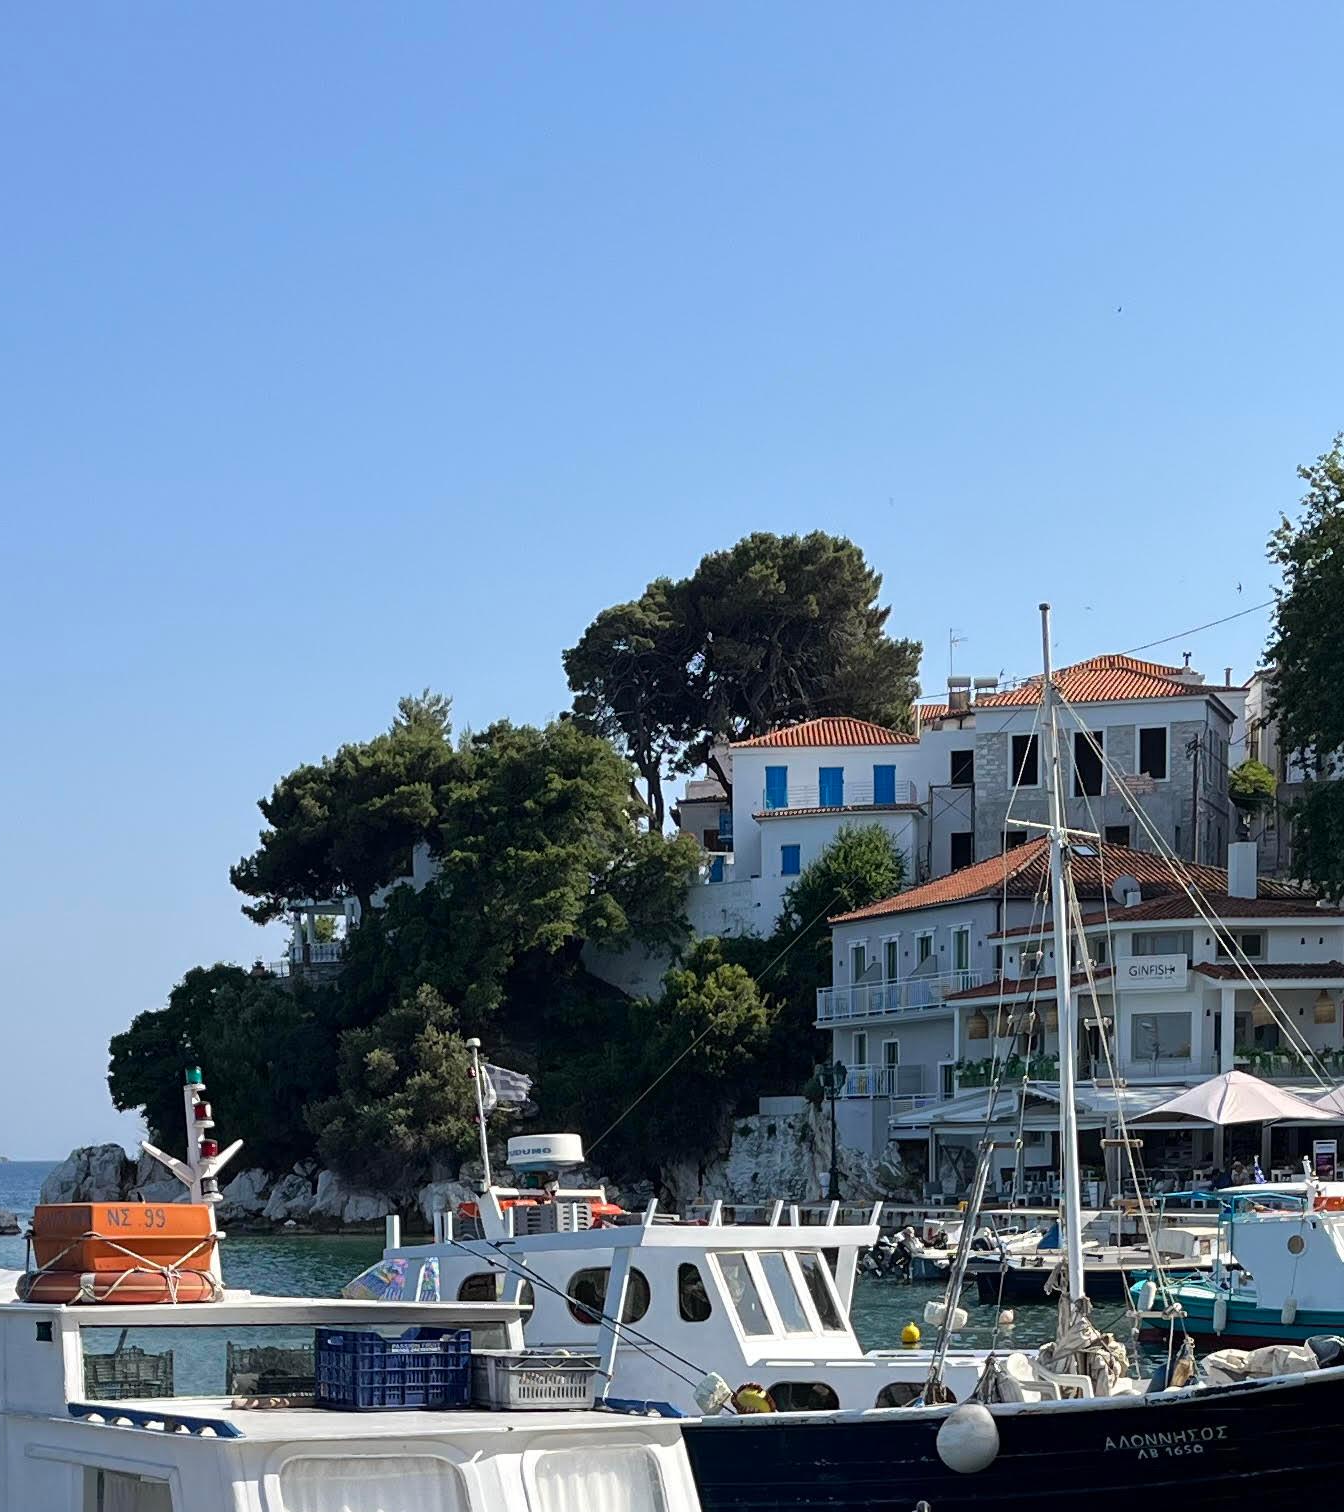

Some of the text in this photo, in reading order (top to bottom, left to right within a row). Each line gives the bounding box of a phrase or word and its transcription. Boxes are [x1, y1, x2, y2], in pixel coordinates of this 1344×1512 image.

[1128, 964, 1175, 977] GINFISH
[1104, 1425, 1228, 1450] ΑΛΟΝΝΗΣΟΣ
[1165, 1444, 1204, 1457] 1650
